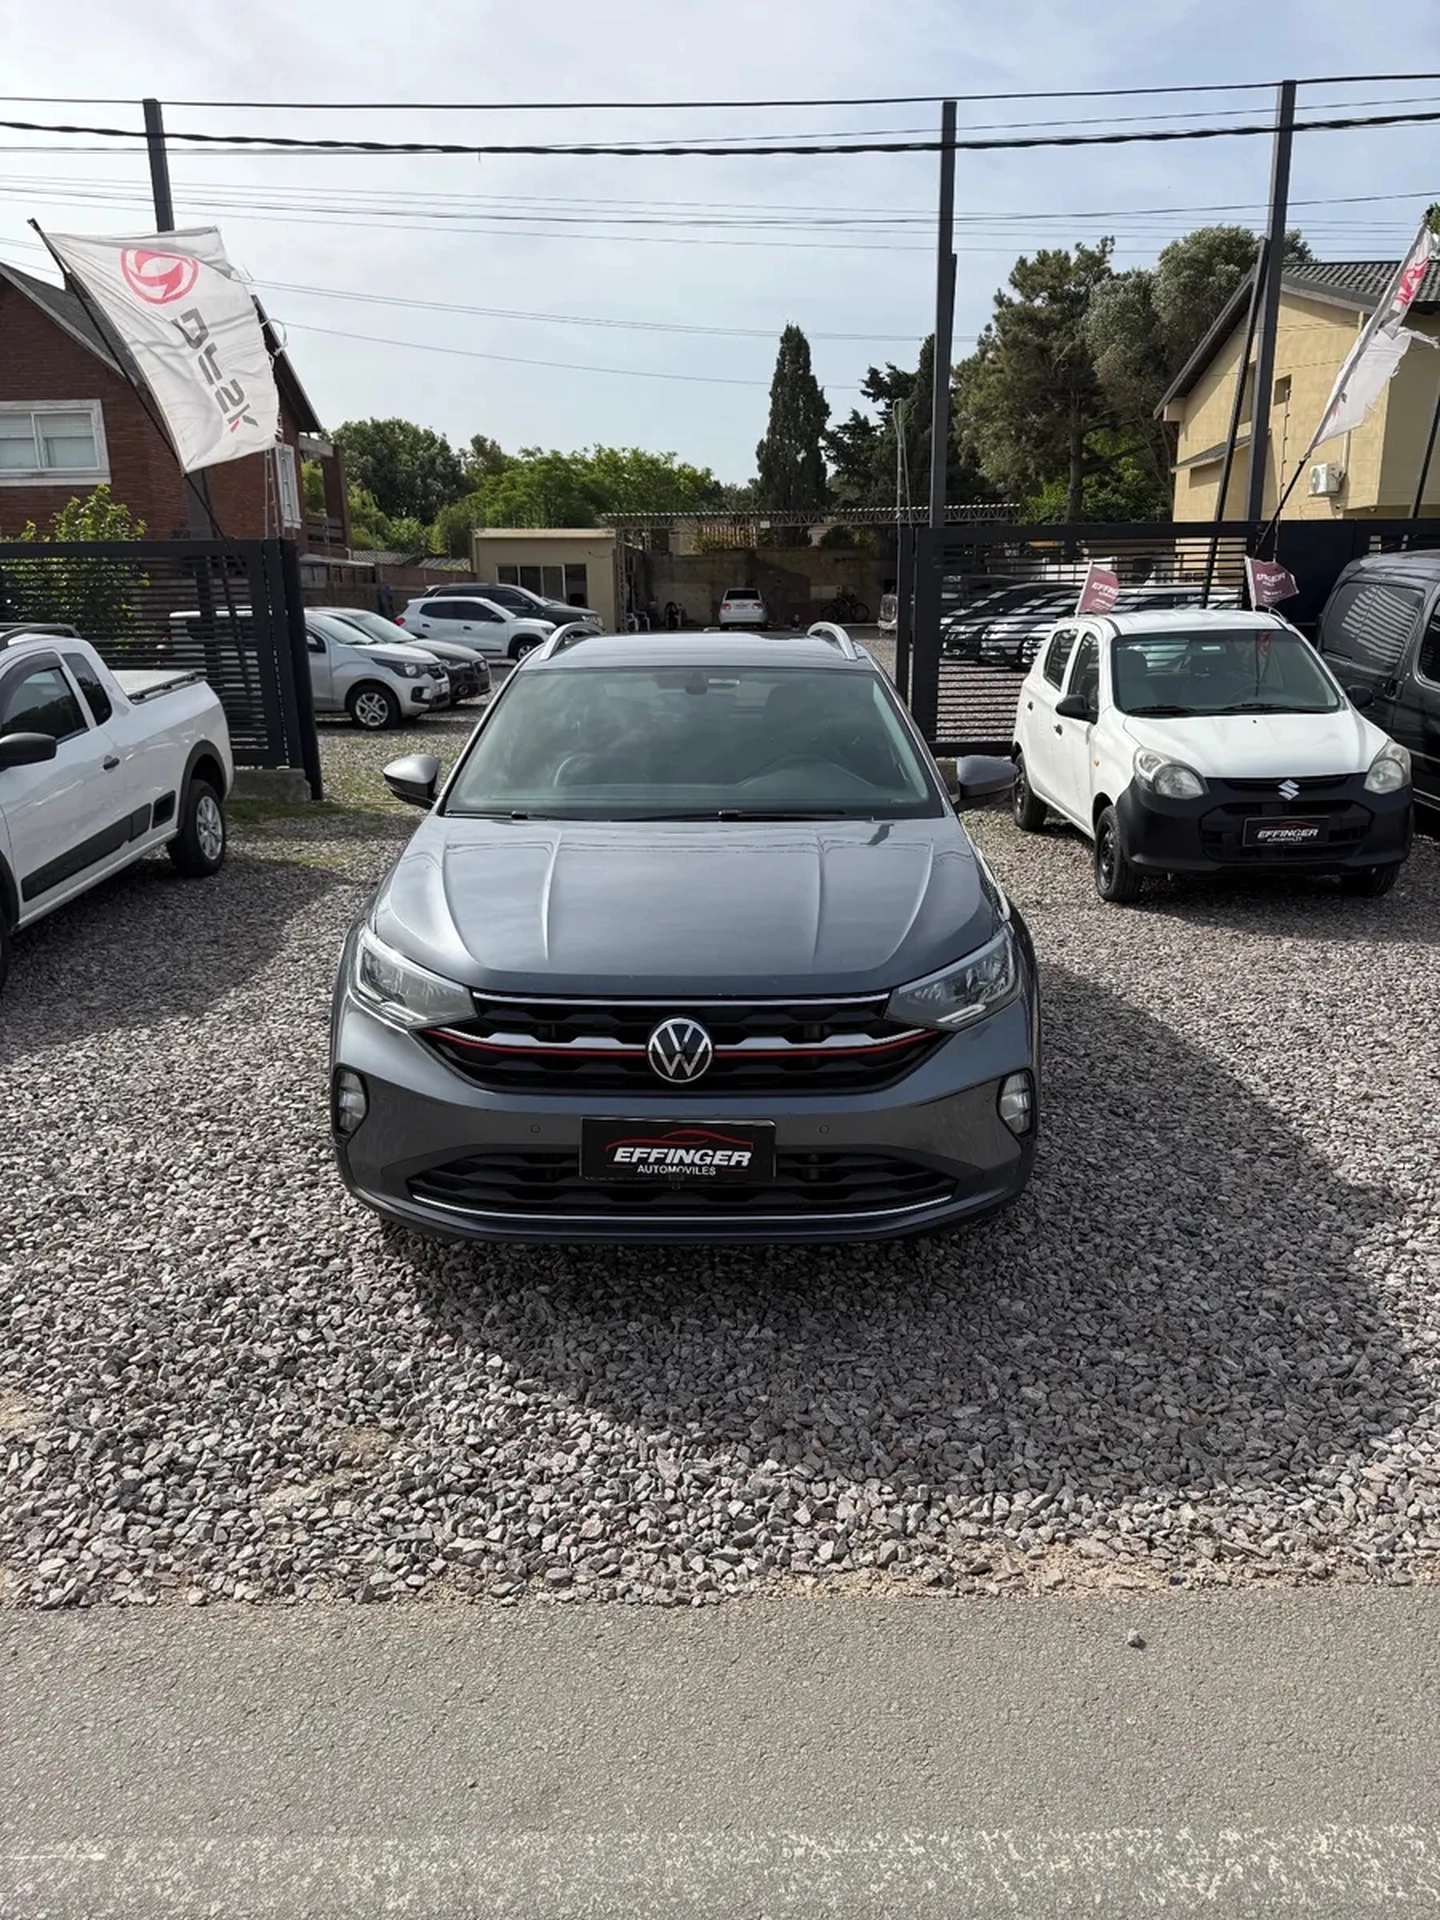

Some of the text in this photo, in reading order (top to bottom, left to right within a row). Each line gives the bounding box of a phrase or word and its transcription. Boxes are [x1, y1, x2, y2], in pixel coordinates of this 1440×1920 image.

[1257, 828, 1320, 840] EFFINGER
[613, 1146, 753, 1168] EFFINGER
[636, 1163, 717, 1177] AUTOMOVILES
